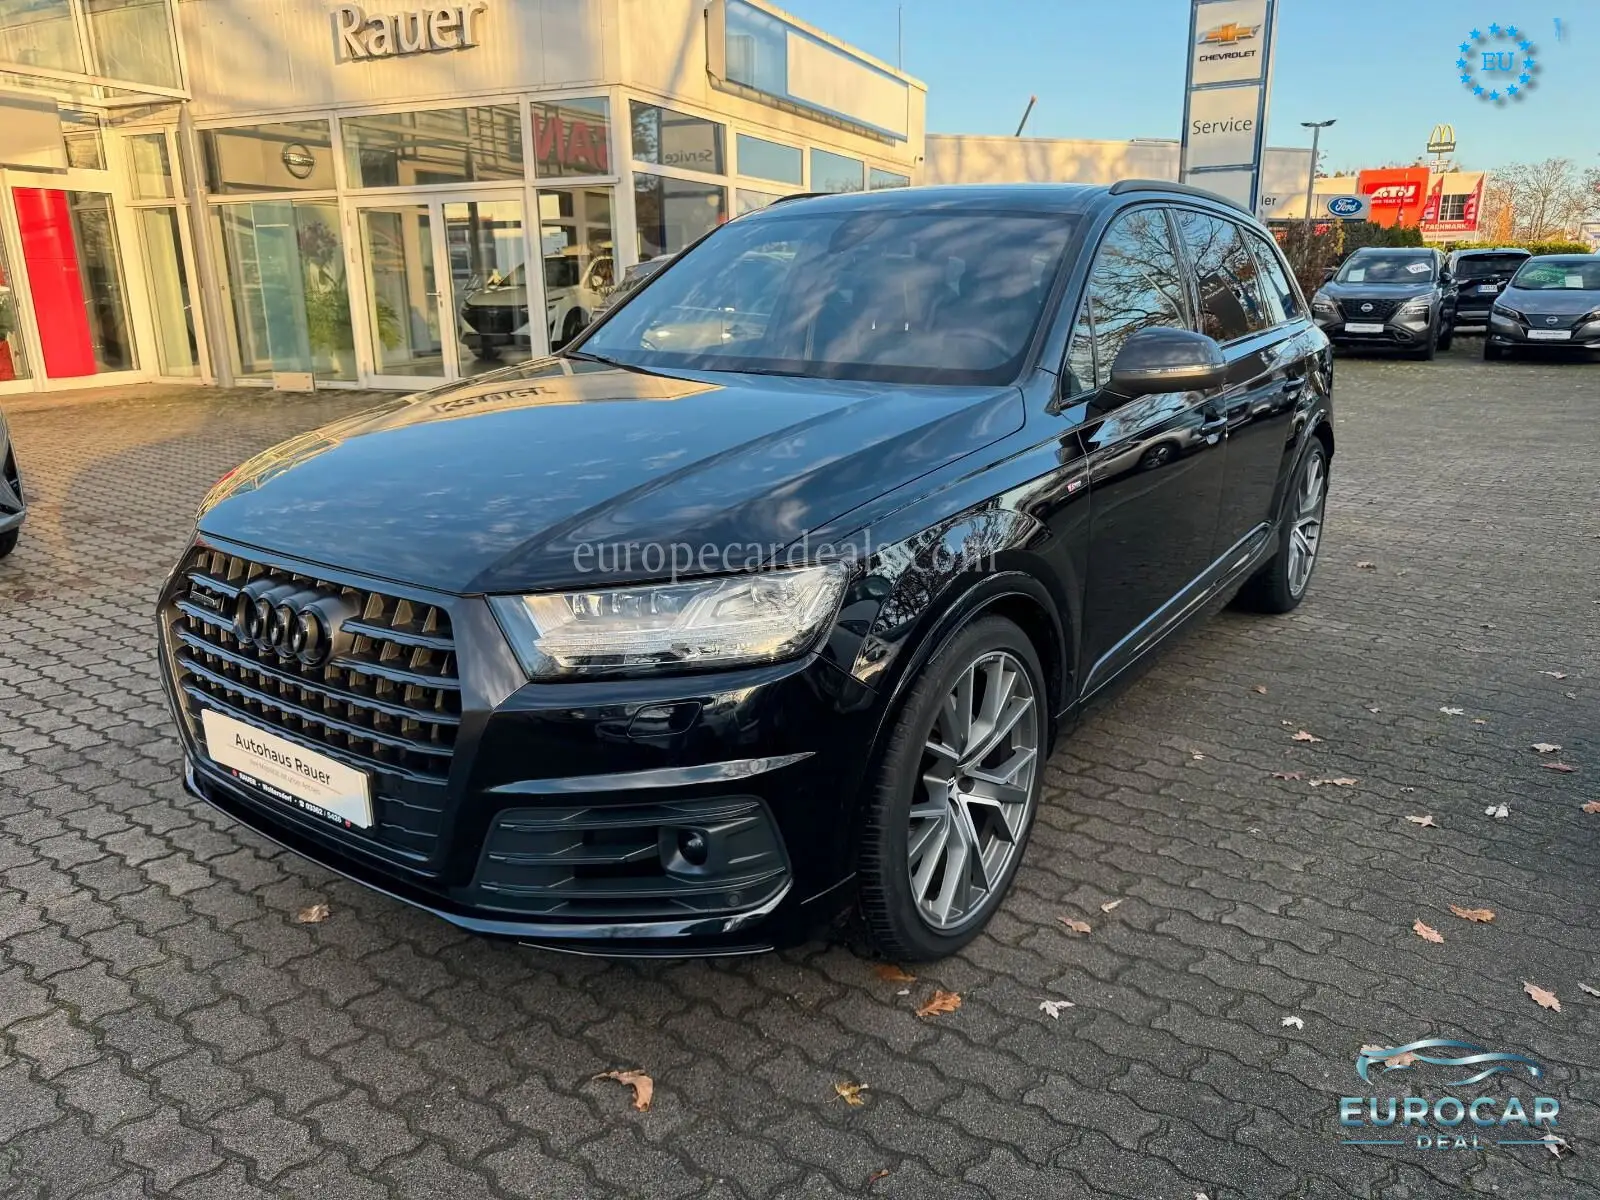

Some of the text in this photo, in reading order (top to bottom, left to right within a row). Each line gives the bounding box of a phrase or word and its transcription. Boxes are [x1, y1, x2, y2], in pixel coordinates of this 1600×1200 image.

[334, 1, 488, 59] Rauer
[1199, 50, 1256, 62] CHEVROLET
[1192, 116, 1252, 135] Service
[1335, 199, 1358, 212] Ford
[235, 733, 292, 768] Autohaus
[294, 758, 331, 785] Rauer
